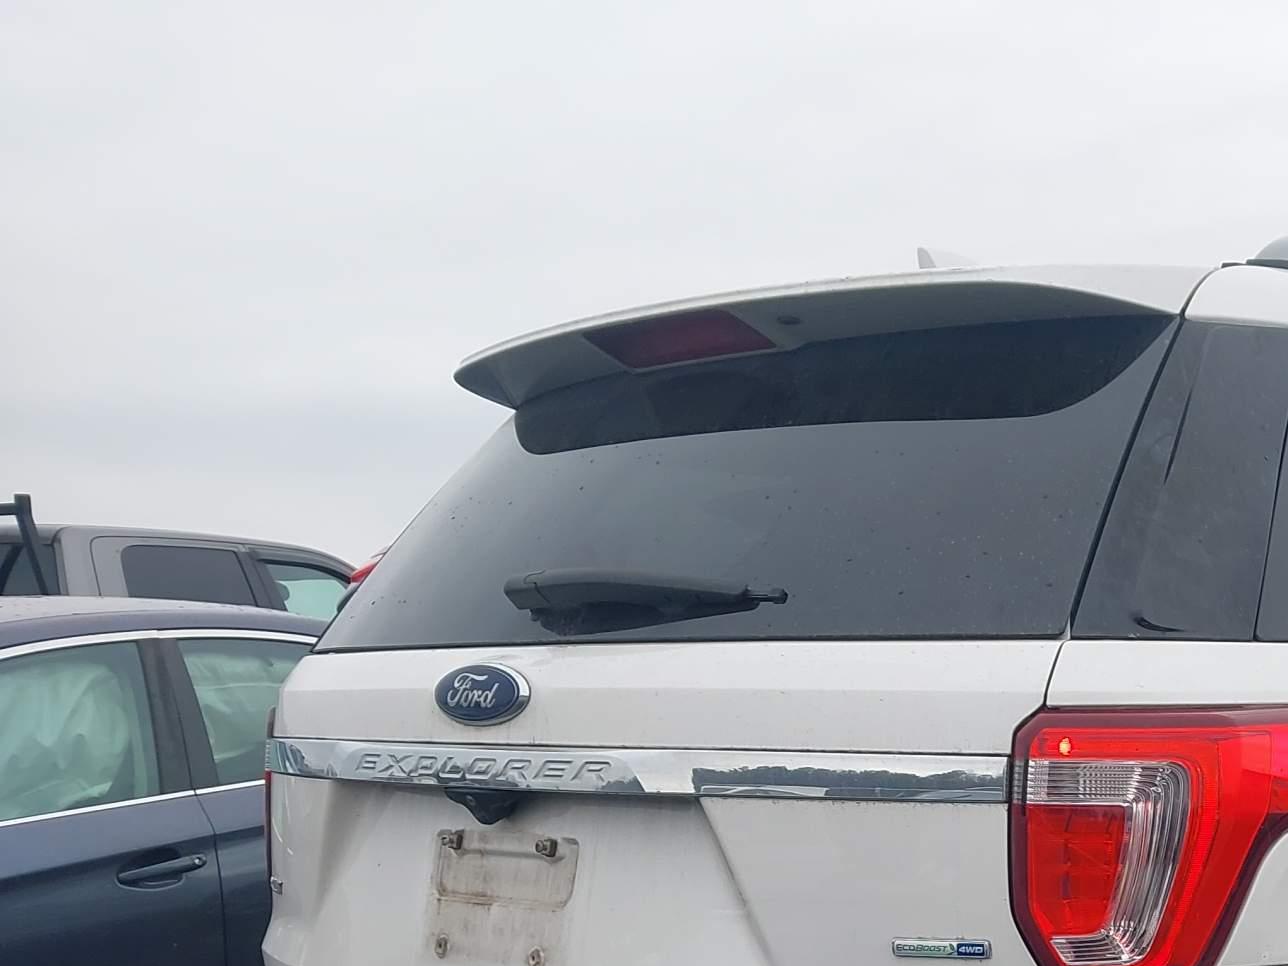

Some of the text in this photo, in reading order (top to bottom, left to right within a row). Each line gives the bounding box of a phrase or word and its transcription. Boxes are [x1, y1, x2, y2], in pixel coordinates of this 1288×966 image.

[447, 672, 500, 708] Ford
[355, 752, 612, 782] EXPLORER
[958, 945, 984, 954] 4WD
